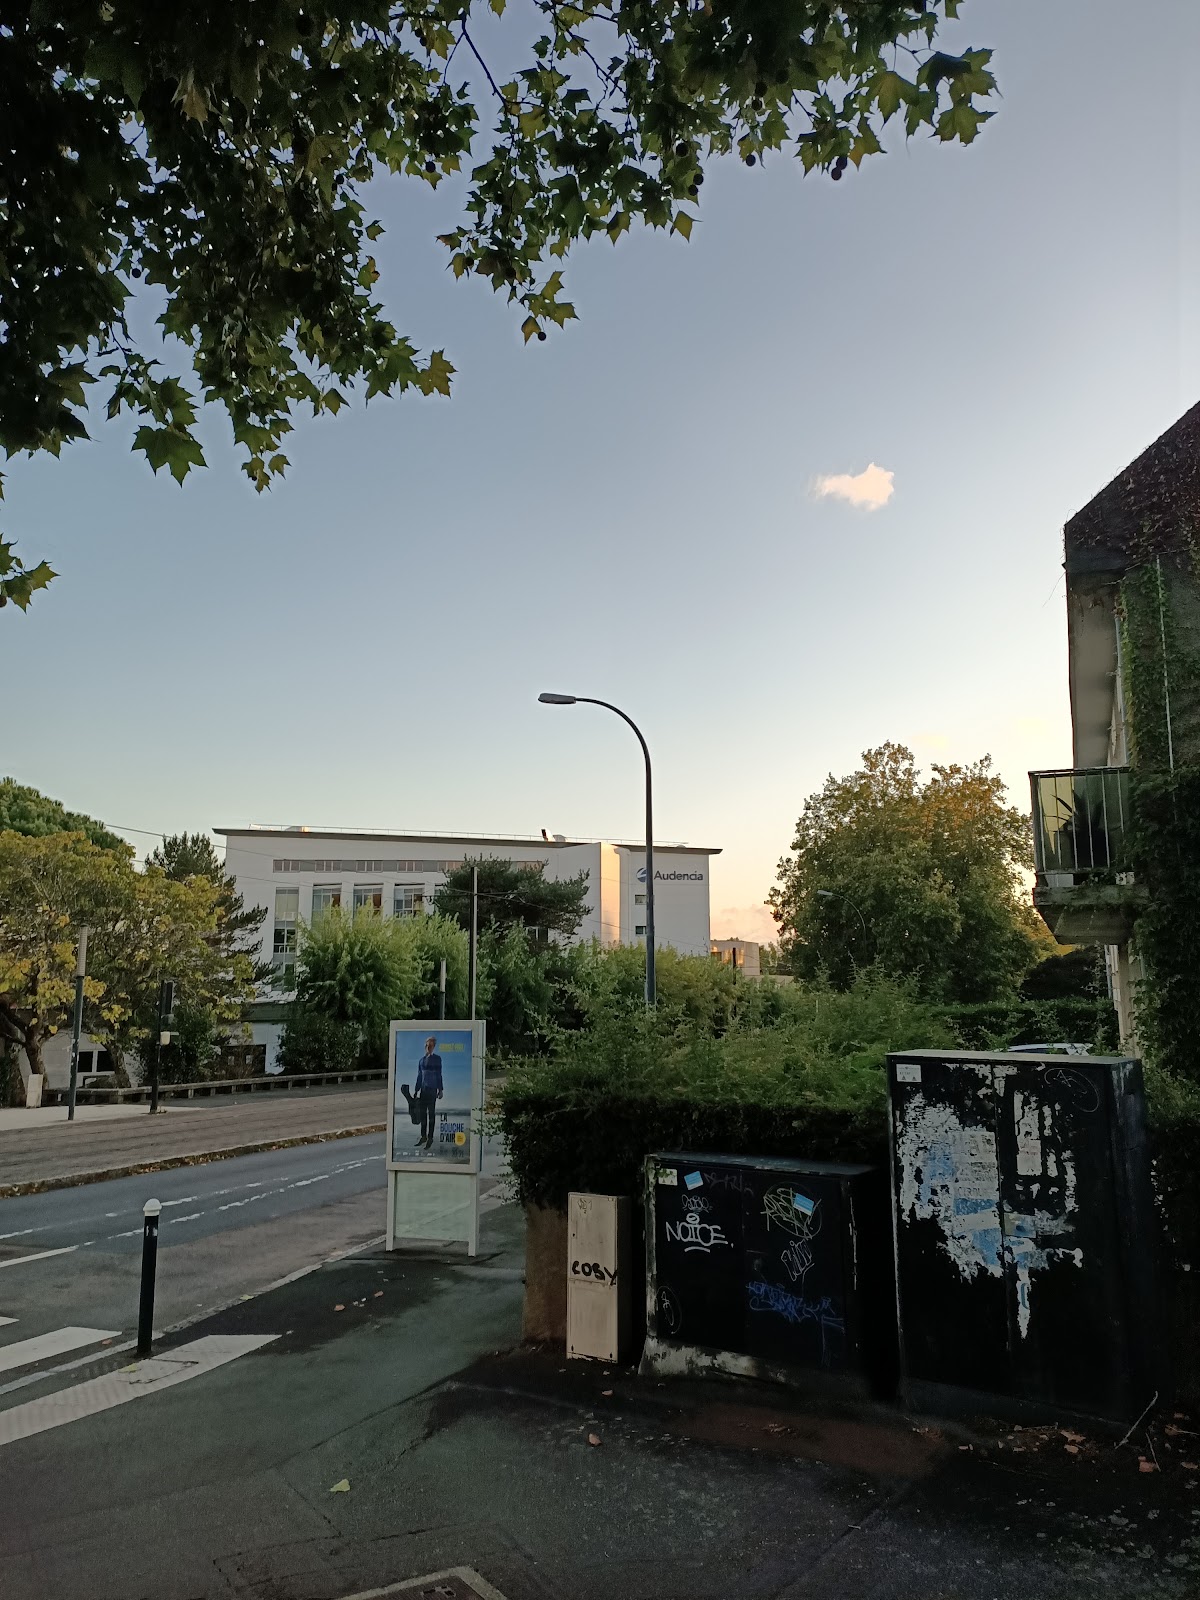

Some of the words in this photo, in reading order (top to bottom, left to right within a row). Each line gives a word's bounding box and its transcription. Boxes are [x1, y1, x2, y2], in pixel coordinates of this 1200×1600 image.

[653, 870, 704, 881] Audencia
[440, 1113, 448, 1122] LA
[440, 1122, 464, 1133] BOUCHE
